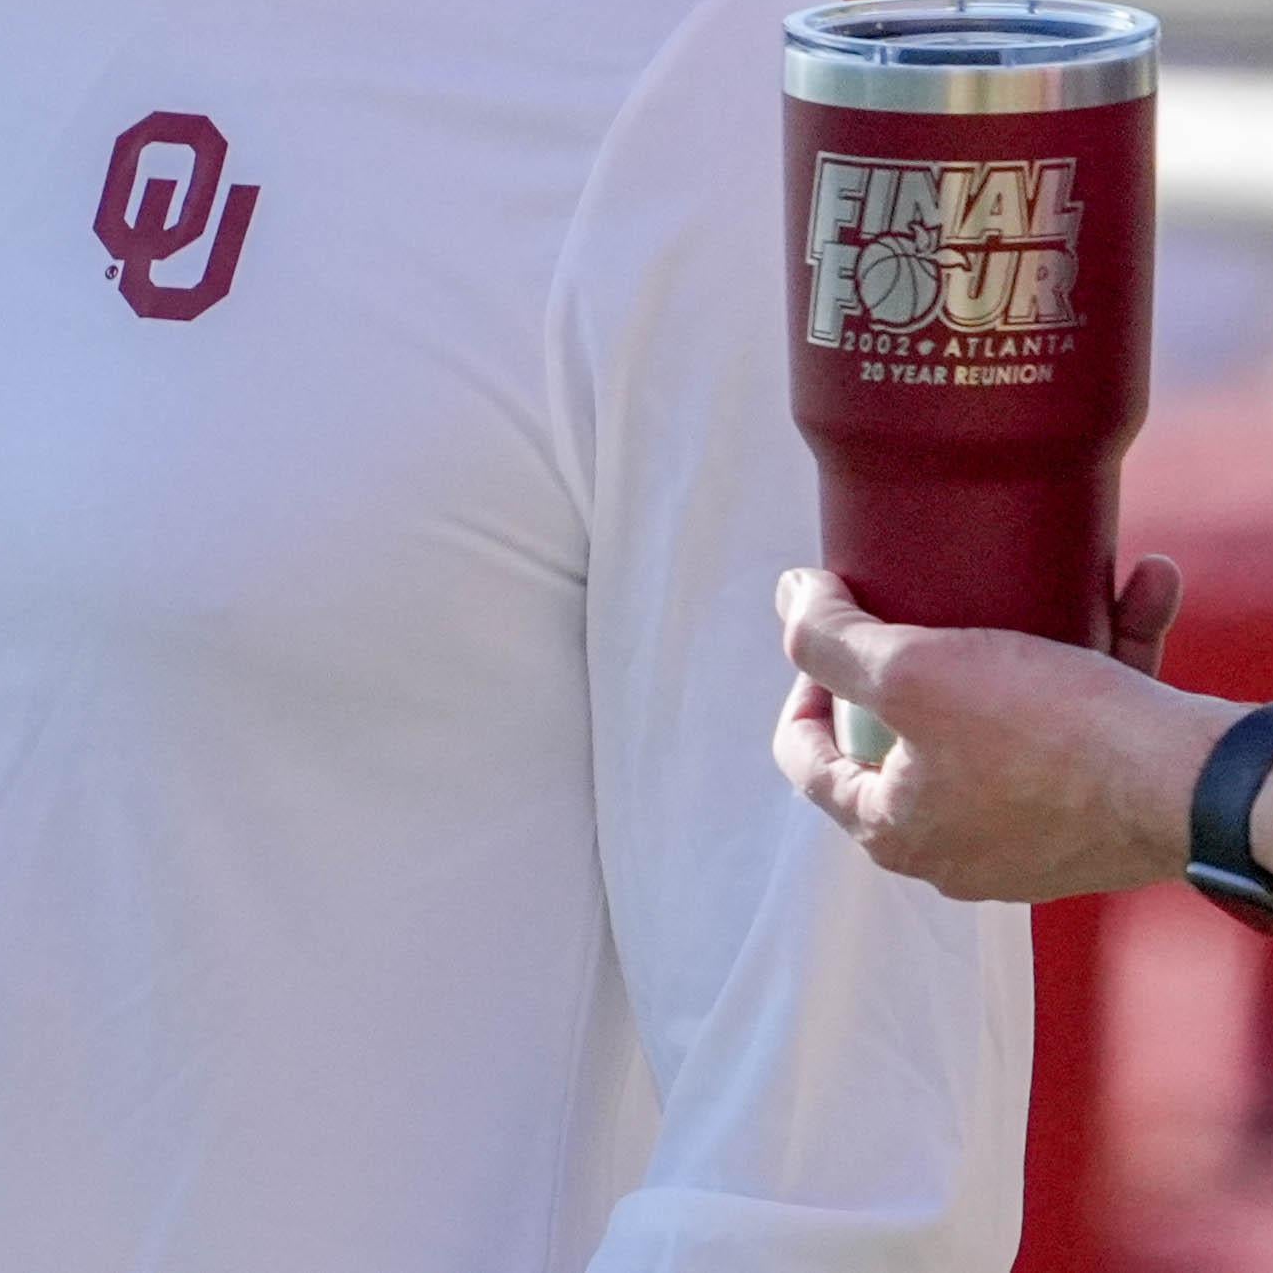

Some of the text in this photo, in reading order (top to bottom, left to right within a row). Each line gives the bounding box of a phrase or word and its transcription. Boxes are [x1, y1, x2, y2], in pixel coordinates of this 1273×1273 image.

[93, 111, 261, 321] OU
[809, 151, 1084, 245] FINAL
[842, 331, 1076, 359] 2002 ATLANTA
[860, 362, 1055, 387] 20 YEAR REUNION
